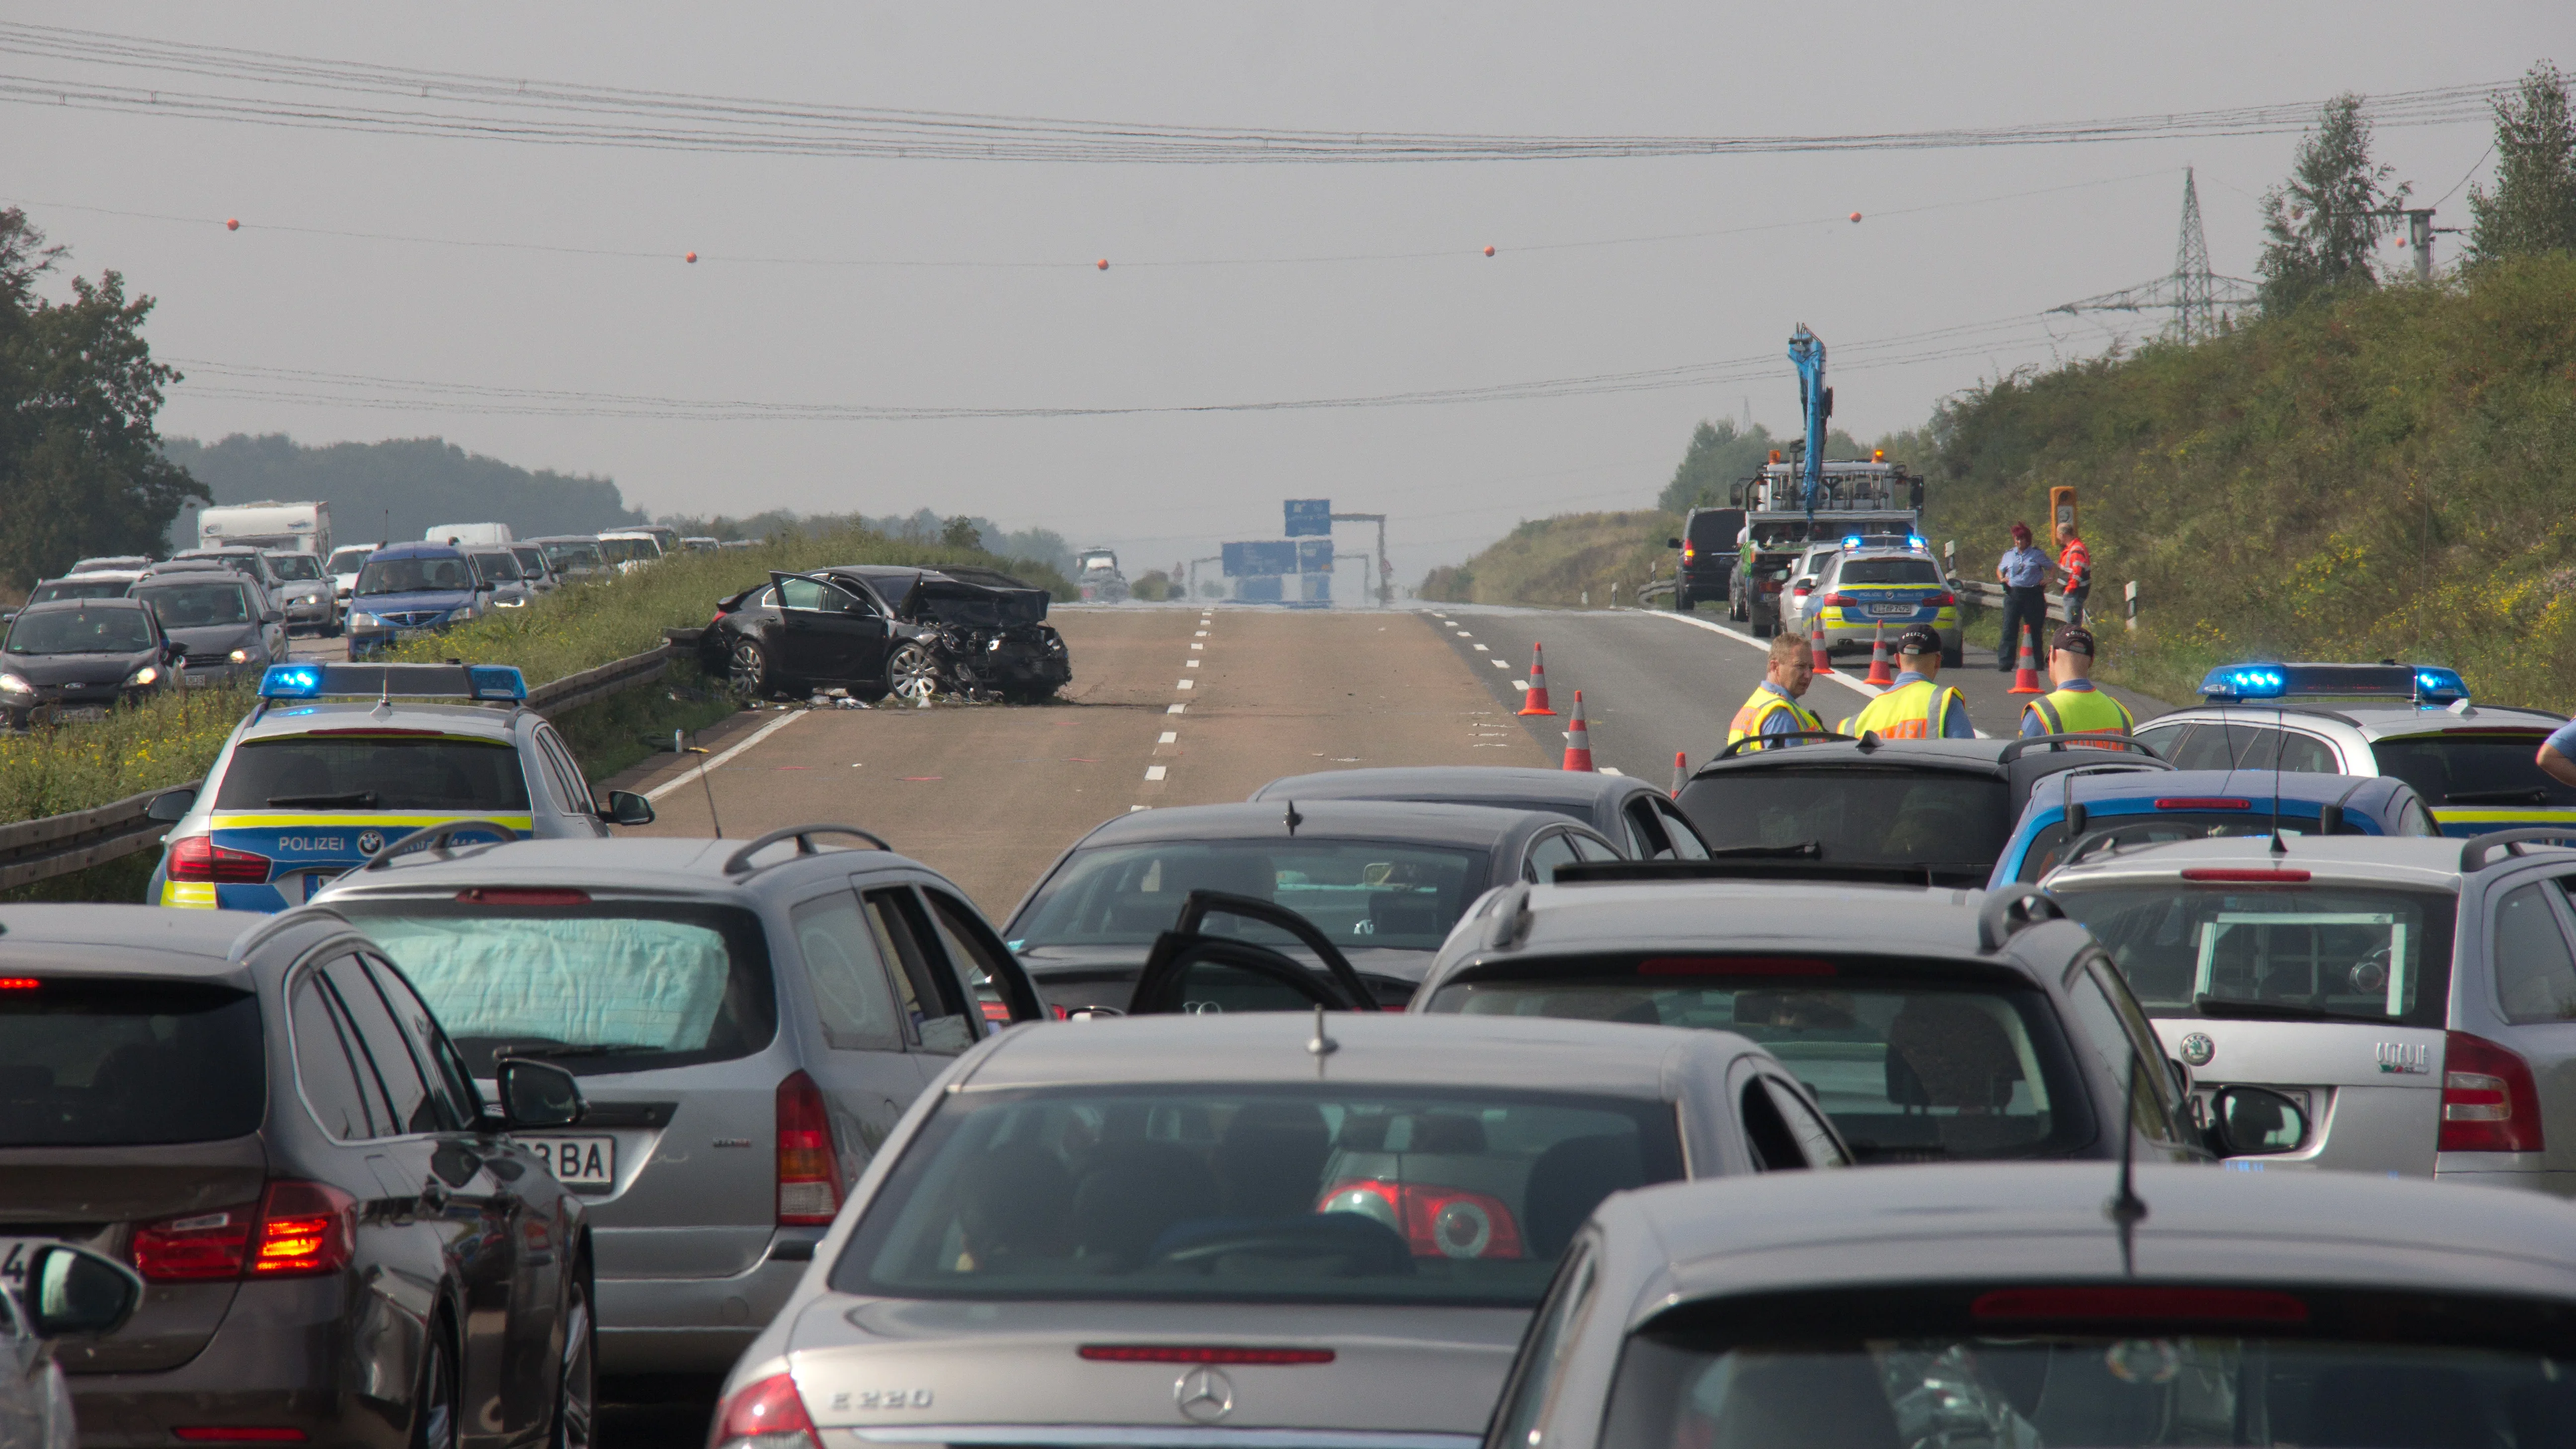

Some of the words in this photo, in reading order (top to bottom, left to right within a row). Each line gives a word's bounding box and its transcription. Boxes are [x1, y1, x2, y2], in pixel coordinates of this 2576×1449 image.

[1901, 632, 1929, 641] POLIZEI
[279, 836, 345, 851] POLIZEI
[829, 1391, 850, 1410] E
[858, 1388, 935, 1410] 220
